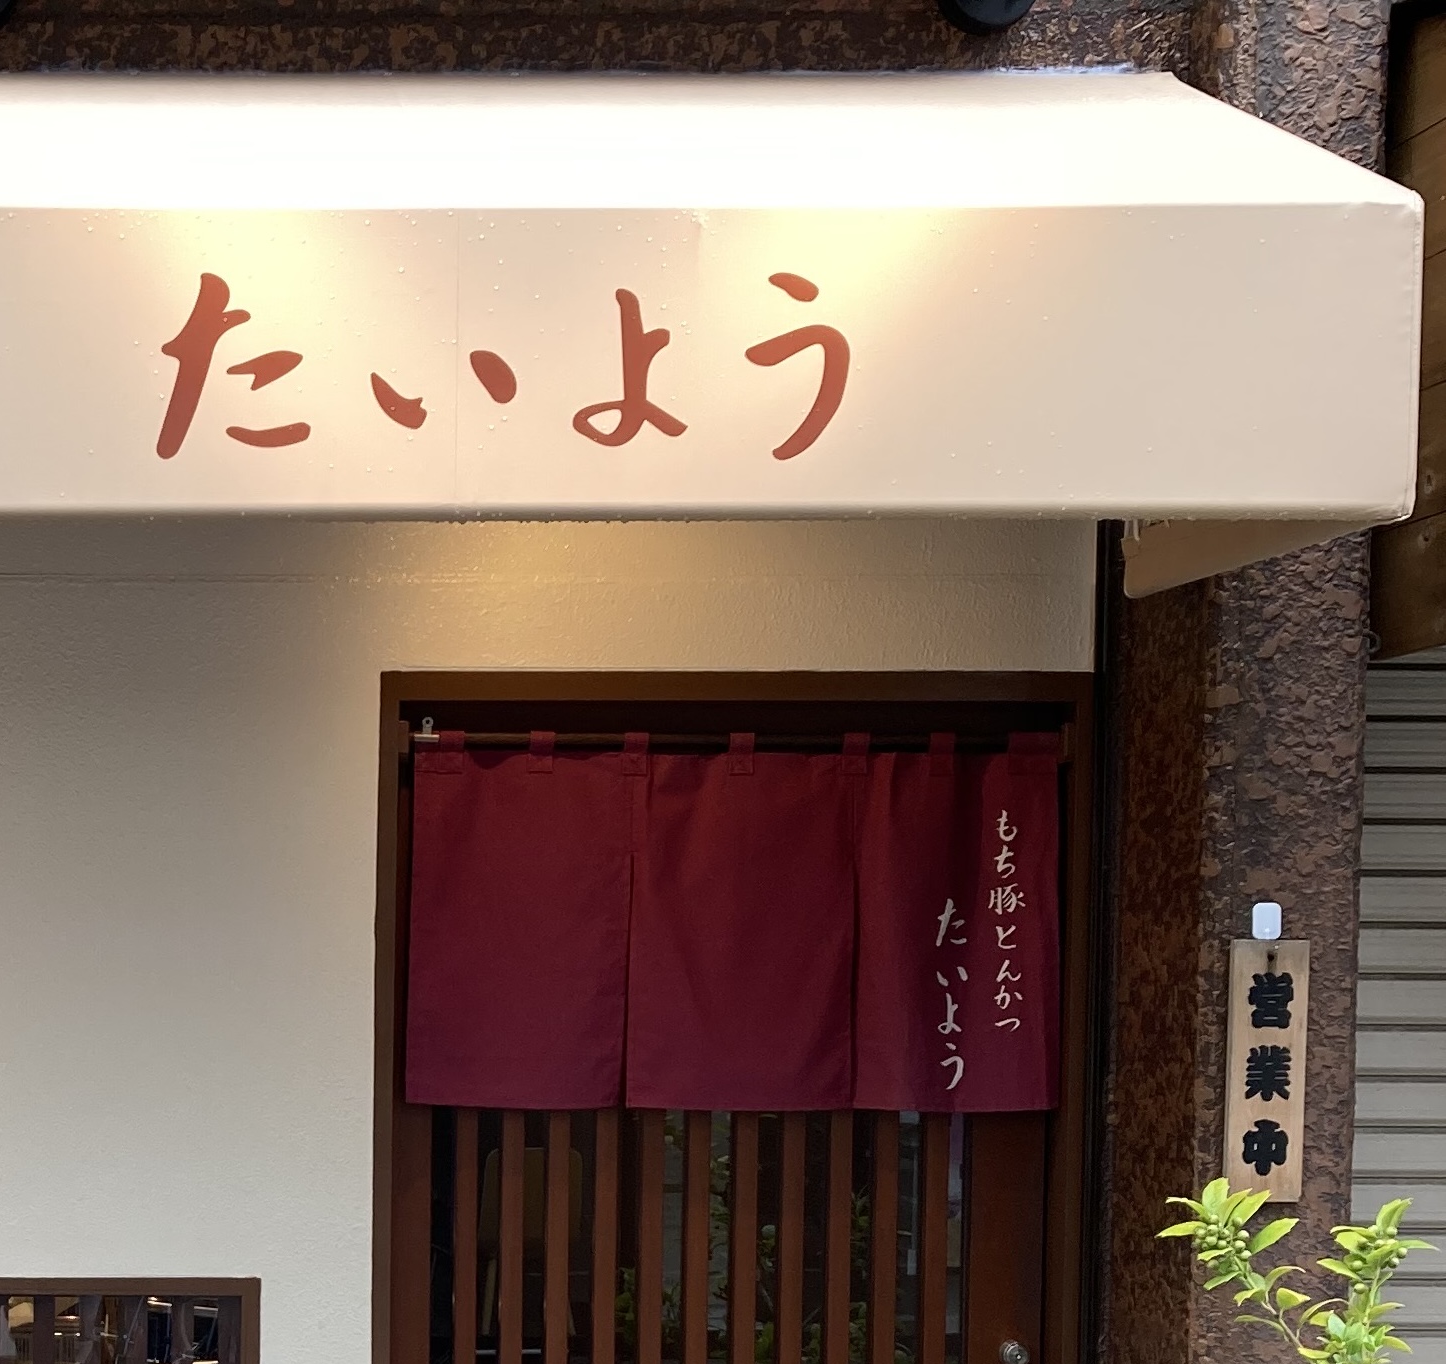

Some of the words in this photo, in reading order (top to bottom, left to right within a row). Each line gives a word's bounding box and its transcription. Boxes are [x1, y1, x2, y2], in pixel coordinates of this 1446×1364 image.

[156, 272, 851, 460] たいよう
[935, 898, 969, 1090] たいよう
[988, 810, 1026, 1032] もち豚とんかつ
[1242, 972, 1294, 1176] 営業中
